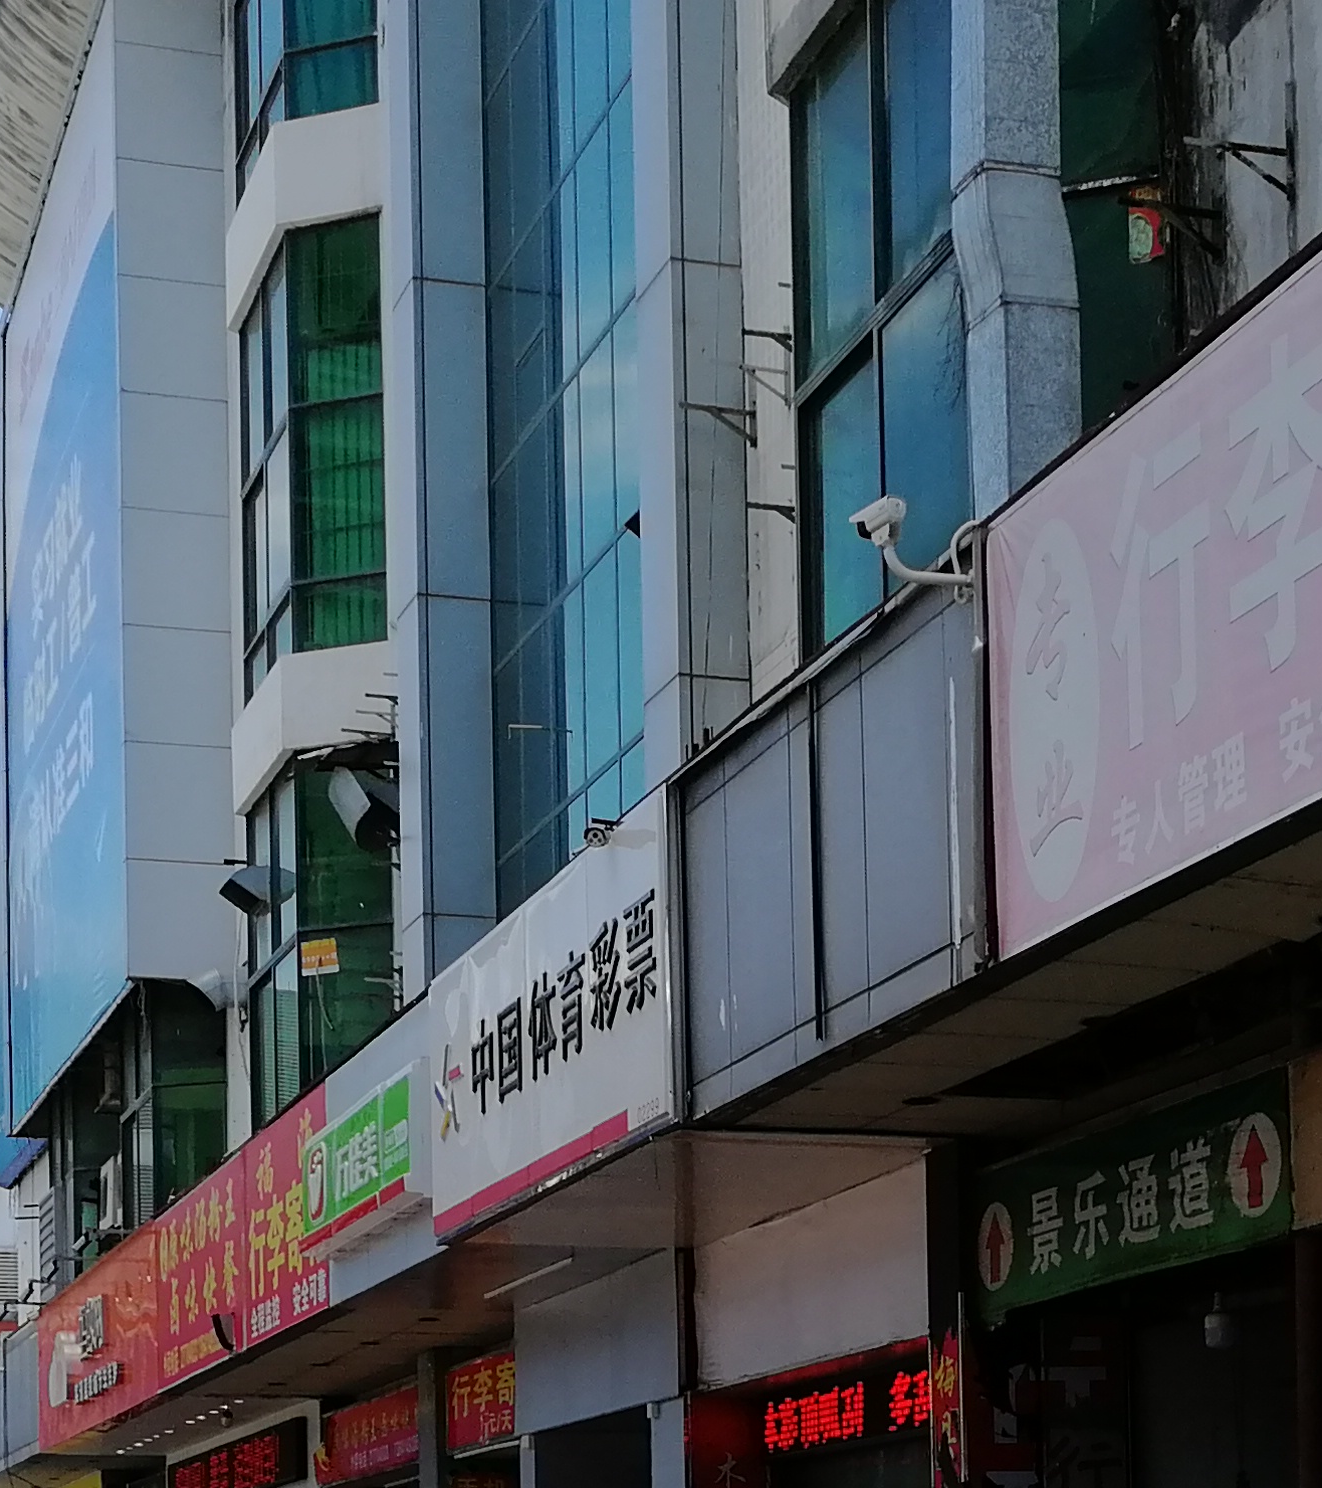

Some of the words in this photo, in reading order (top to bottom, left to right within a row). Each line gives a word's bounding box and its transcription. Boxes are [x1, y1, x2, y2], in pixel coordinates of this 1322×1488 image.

[1110, 732, 1247, 866] 专人管理
[471, 888, 657, 1115] 中国体育彩票
[248, 1179, 321, 1300] 行李寄
[1027, 1136, 1214, 1276] 景乐通道
[292, 1267, 327, 1316] 安全可靠
